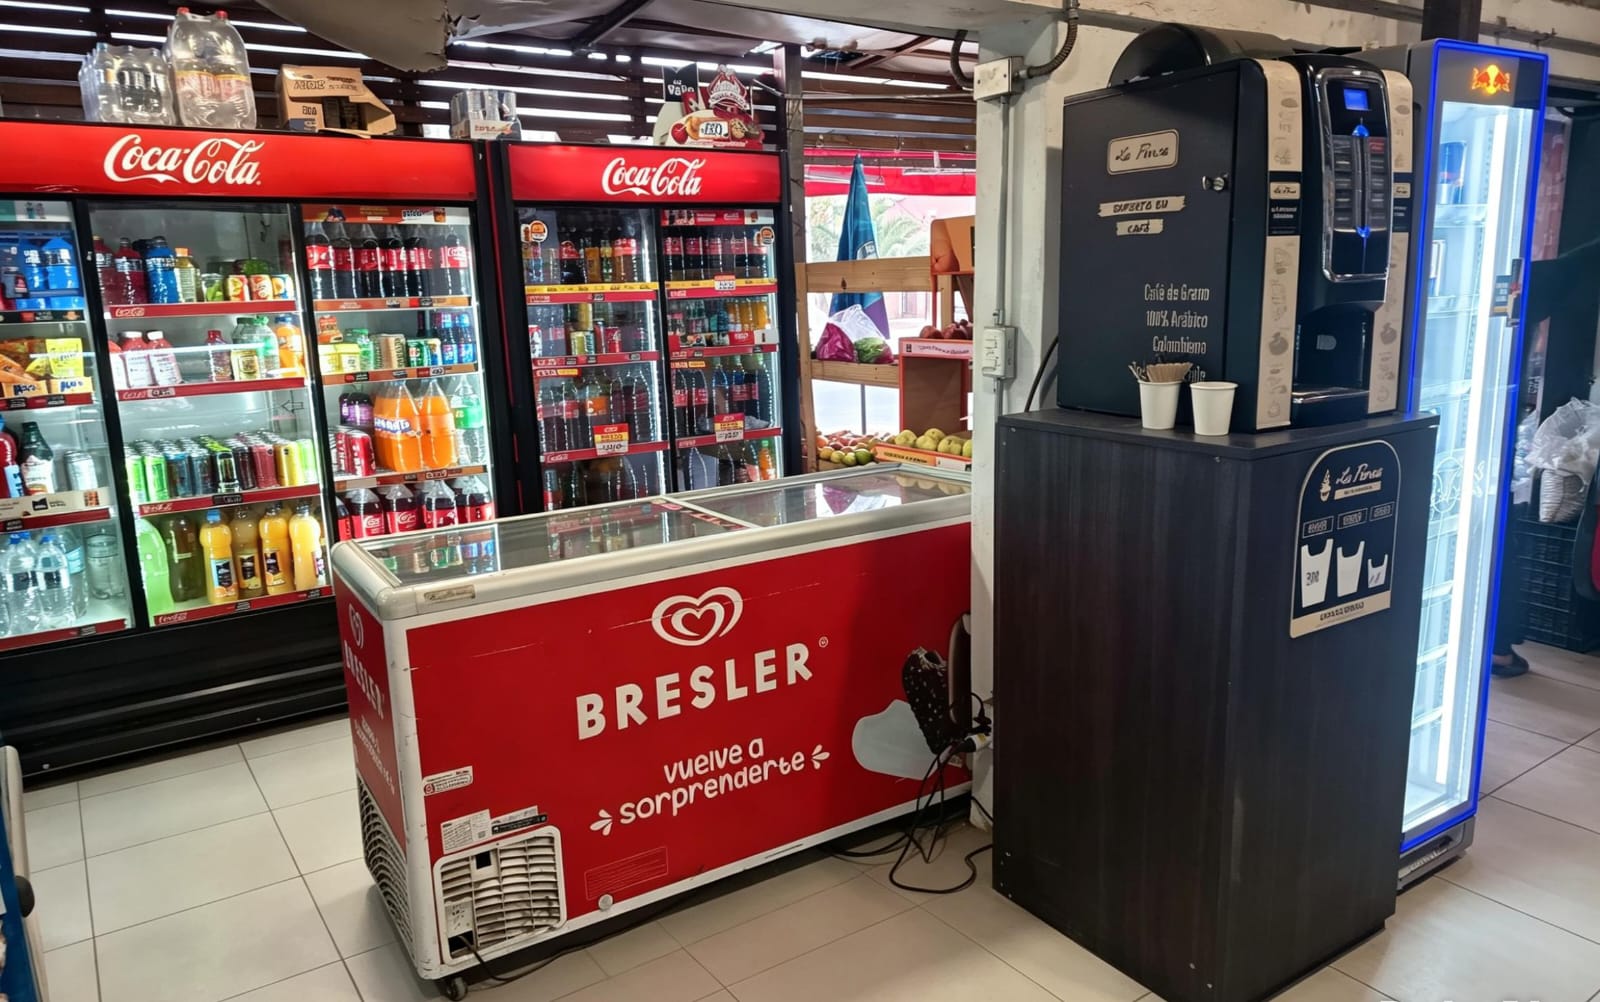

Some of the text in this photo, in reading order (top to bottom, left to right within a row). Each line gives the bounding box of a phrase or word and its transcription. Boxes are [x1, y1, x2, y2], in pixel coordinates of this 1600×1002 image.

[104, 134, 265, 185] Coca-Cola
[602, 157, 706, 196] Coca-Cola
[1144, 283, 1165, 301] Café
[1146, 310, 1169, 327] 100%
[576, 642, 813, 740] BRESLER
[619, 751, 805, 816] sorprenderte
[664, 737, 765, 784] vuelve a
